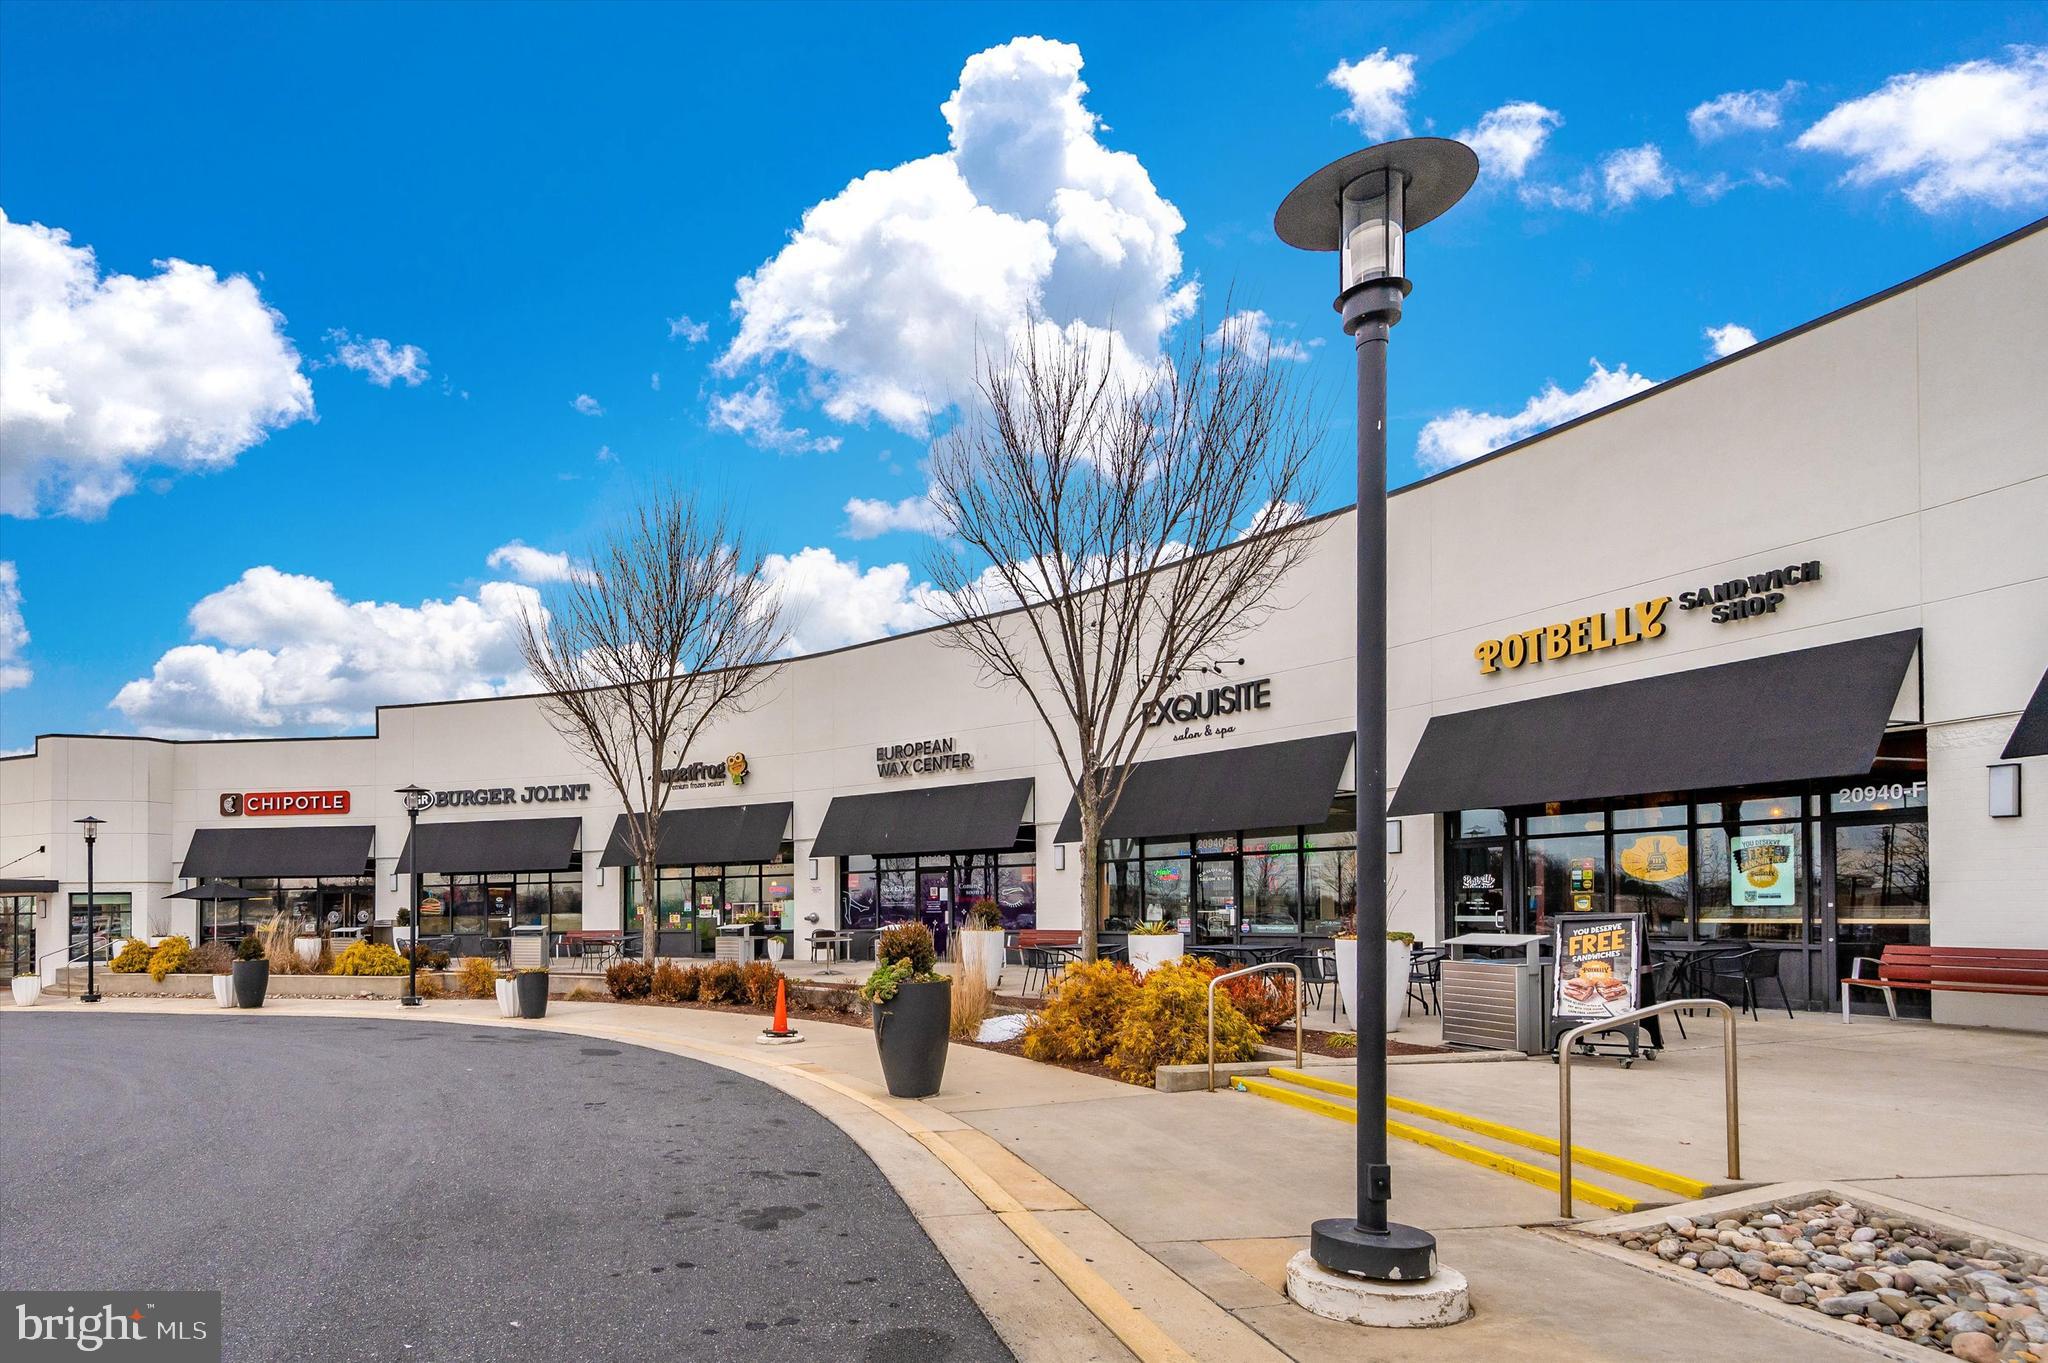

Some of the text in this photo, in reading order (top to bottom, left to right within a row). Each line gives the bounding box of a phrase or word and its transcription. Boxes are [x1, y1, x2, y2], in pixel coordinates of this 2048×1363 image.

[1474, 560, 1823, 675] POTBELLY SANDWICH
[1711, 592, 1786, 624] SHOP
[1143, 678, 1271, 727] EXQUISITE
[1173, 724, 1236, 741] salon & spa
[876, 737, 955, 762] EUROPEAN
[660, 762, 726, 783] weetFrog
[877, 753, 973, 777] WAX CENTER
[247, 795, 344, 811] CHIPOTLE
[434, 788, 517, 807] BURGER
[521, 784, 591, 803] JOINT
[1839, 781, 1927, 803] 20940-F
[1573, 922, 1622, 936] YOU DESERVE
[1568, 929, 1626, 956] FREE
[1572, 950, 1621, 963] SANDWICHES
